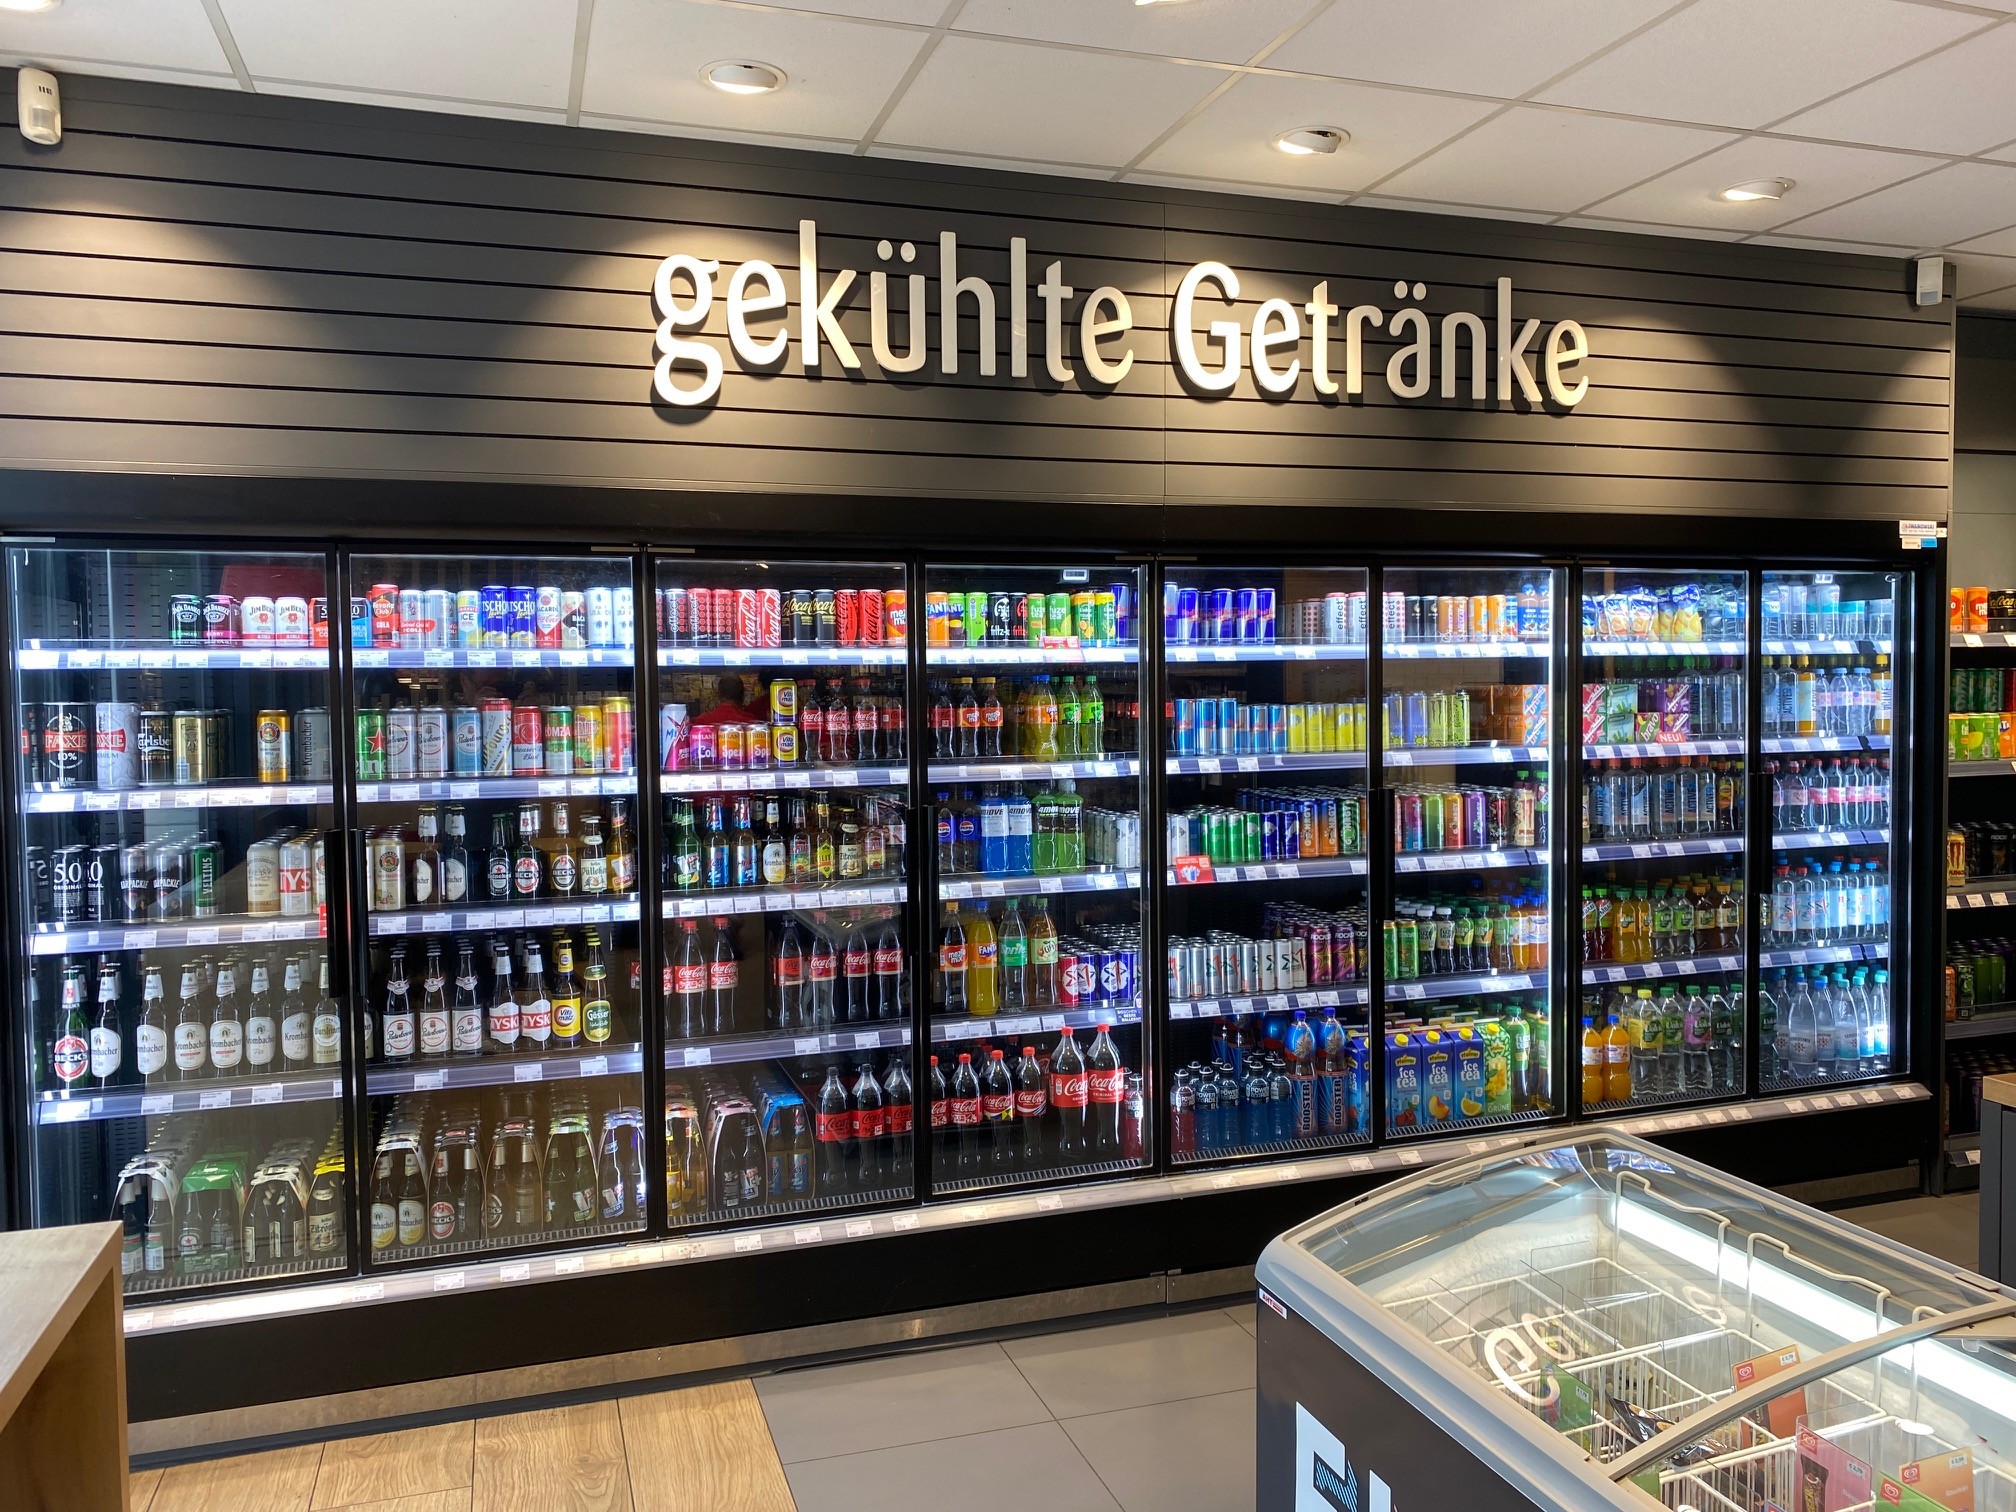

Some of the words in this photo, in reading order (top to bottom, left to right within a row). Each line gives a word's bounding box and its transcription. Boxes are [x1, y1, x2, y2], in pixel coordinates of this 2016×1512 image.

[653, 219, 1134, 405] gekühlte
[1174, 261, 1589, 407] Getränke
[460, 613, 474, 621] ICE
[1049, 612, 1062, 620] tea
[376, 621, 390, 629] COLA
[1641, 713, 1660, 743] bravo
[45, 734, 88, 748] FAXE
[1659, 732, 1684, 742] NEU!
[302, 720, 312, 767] Krombacher
[57, 752, 78, 761] 10%
[1664, 788, 1675, 814] ACTIVE
[1687, 788, 1697, 813] ACTIVE
[53, 862, 82, 884] 5,0
[202, 857, 213, 894] VELTINS
[557, 1014, 574, 1022] malz
[559, 1009, 572, 1017] Vita
[1431, 1063, 1447, 1075] ice
[1463, 1060, 1478, 1071] ice
[1400, 1066, 1414, 1078] ice
[1460, 1070, 1481, 1081] tea
[1396, 1076, 1417, 1088] tea
[1428, 1072, 1448, 1085] tea
[1302, 1083, 1310, 1131] BOOSTER
[1333, 1079, 1342, 1126] BOOSTER
